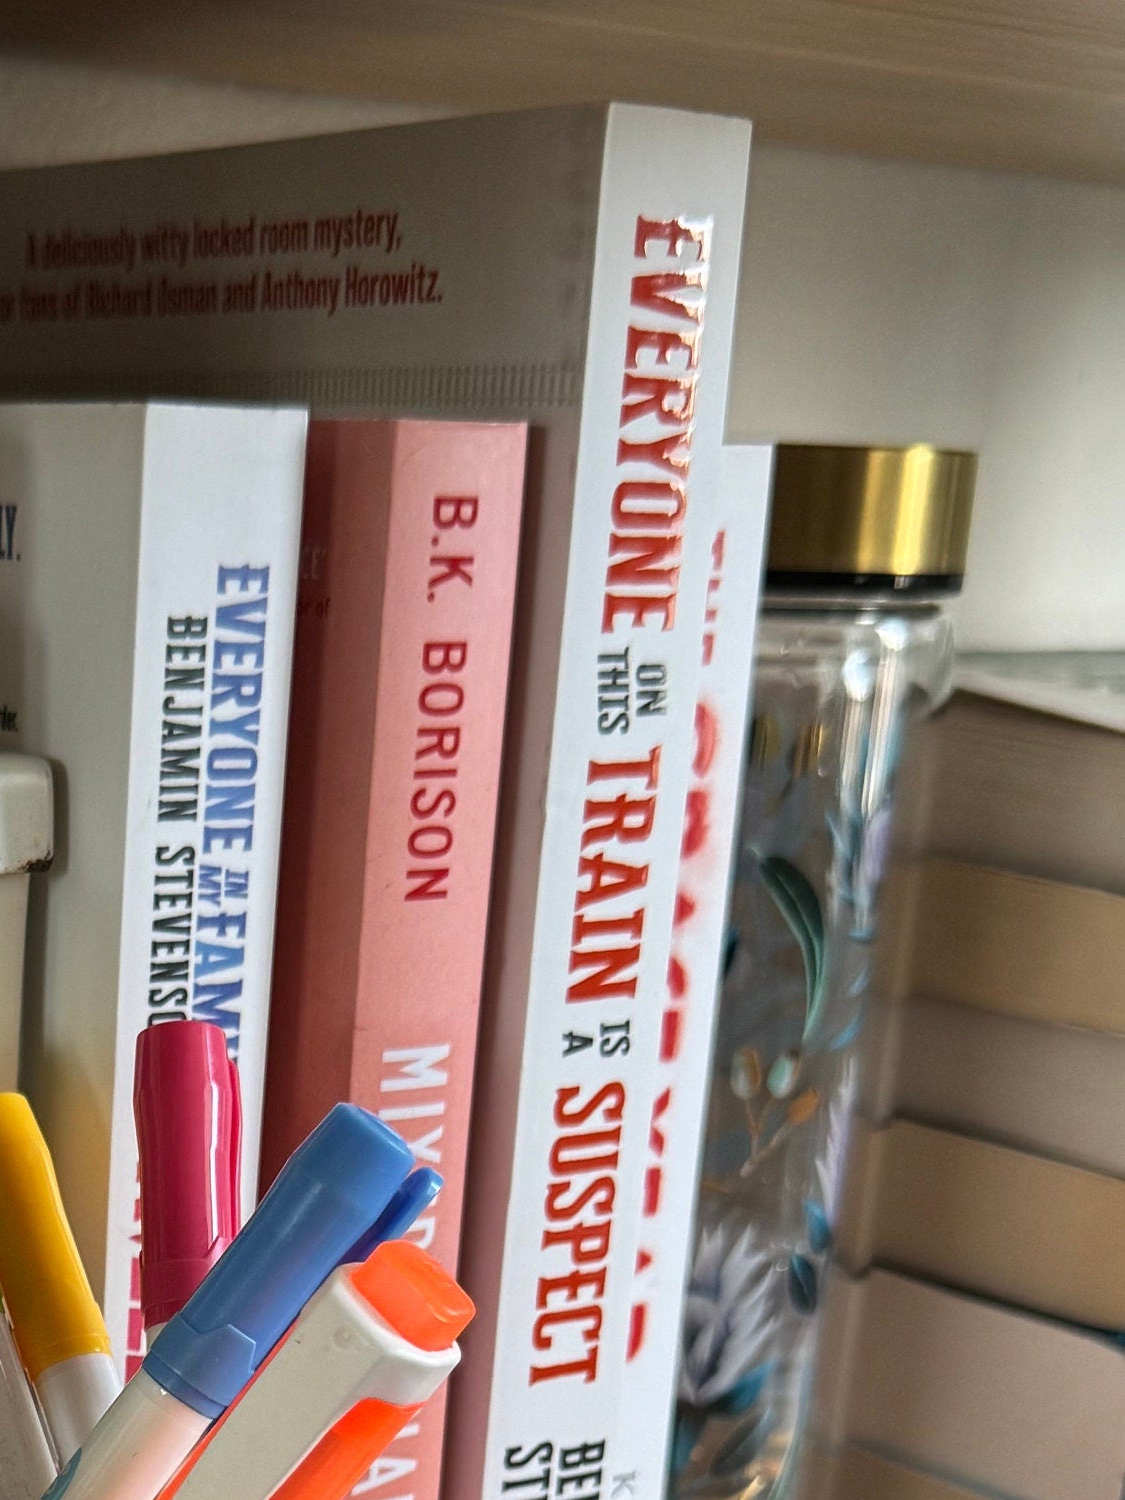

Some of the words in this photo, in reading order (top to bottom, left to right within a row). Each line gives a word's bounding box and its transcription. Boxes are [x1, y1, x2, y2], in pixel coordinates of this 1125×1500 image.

[141, 220, 188, 268] witty
[194, 215, 254, 260] locked
[260, 220, 308, 254] room
[314, 208, 401, 257] mystery,
[157, 276, 218, 317] Osman
[222, 270, 256, 313] and
[261, 270, 340, 317] Anthony
[345, 260, 443, 308] Horowitz.
[601, 213, 714, 635] EVERYONE
[426, 494, 481, 604] B.K.
[156, 615, 209, 824] BENJAMIN
[201, 563, 271, 854] EVERYONE
[597, 646, 630, 736] THIS
[635, 663, 667, 717] ON
[403, 639, 470, 902] BORISON
[199, 865, 225, 906] MY
[224, 868, 250, 898] IN
[566, 746, 661, 1005] TRAIN
[147, 846, 196, 1028] STEVENSO
[562, 1031, 593, 1057] A
[599, 1018, 631, 1058] IS
[529, 1081, 627, 1387] SUSPECT
